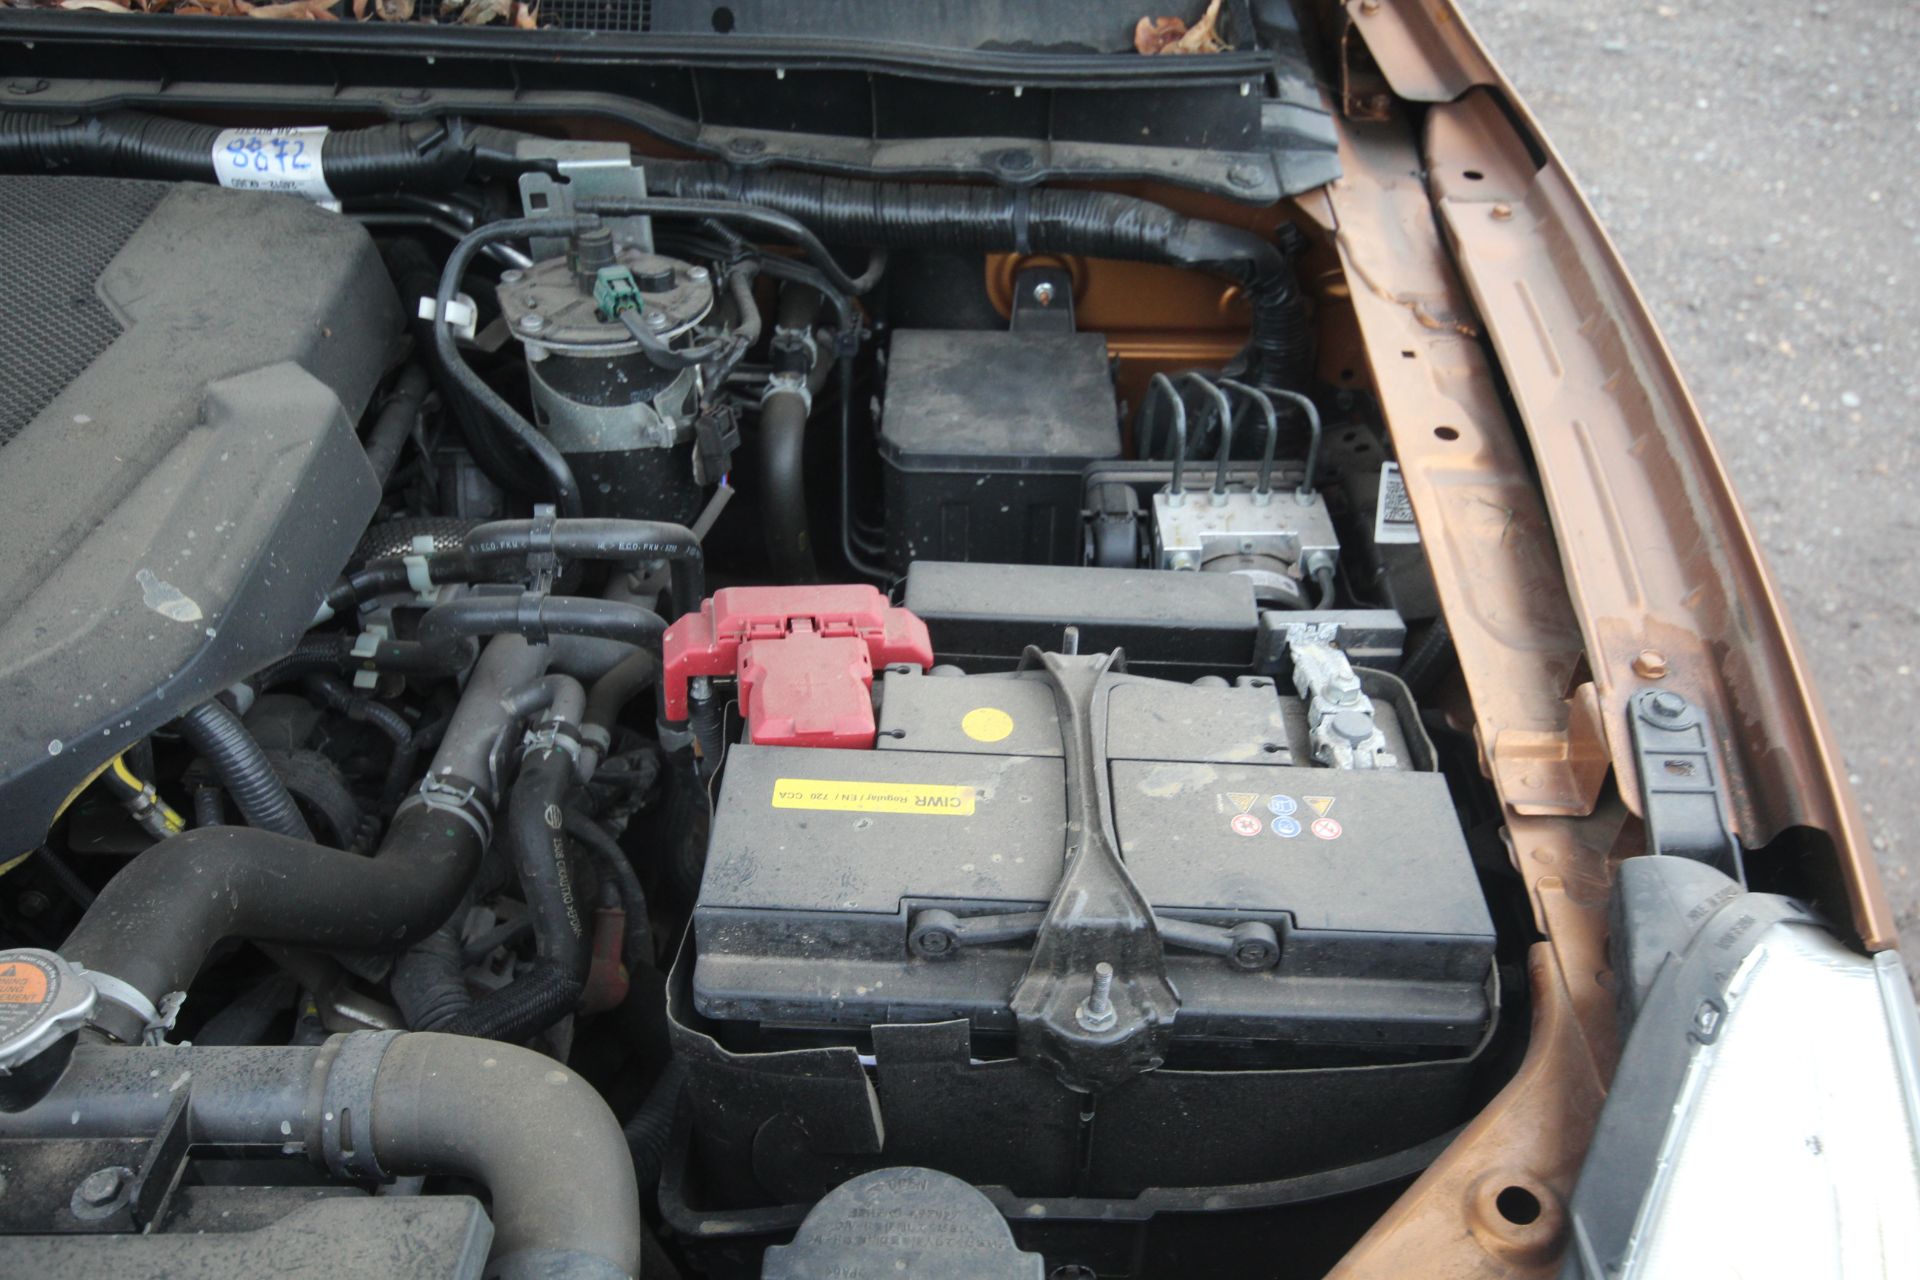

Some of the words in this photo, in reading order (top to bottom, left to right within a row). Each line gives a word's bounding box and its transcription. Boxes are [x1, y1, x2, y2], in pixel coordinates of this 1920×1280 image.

[227, 136, 310, 172] 8872
[778, 791, 803, 800] CCA
[810, 793, 828, 801] 720
[841, 793, 858, 801] EN
[866, 793, 908, 804] Regular
[914, 795, 961, 808] CIWR
